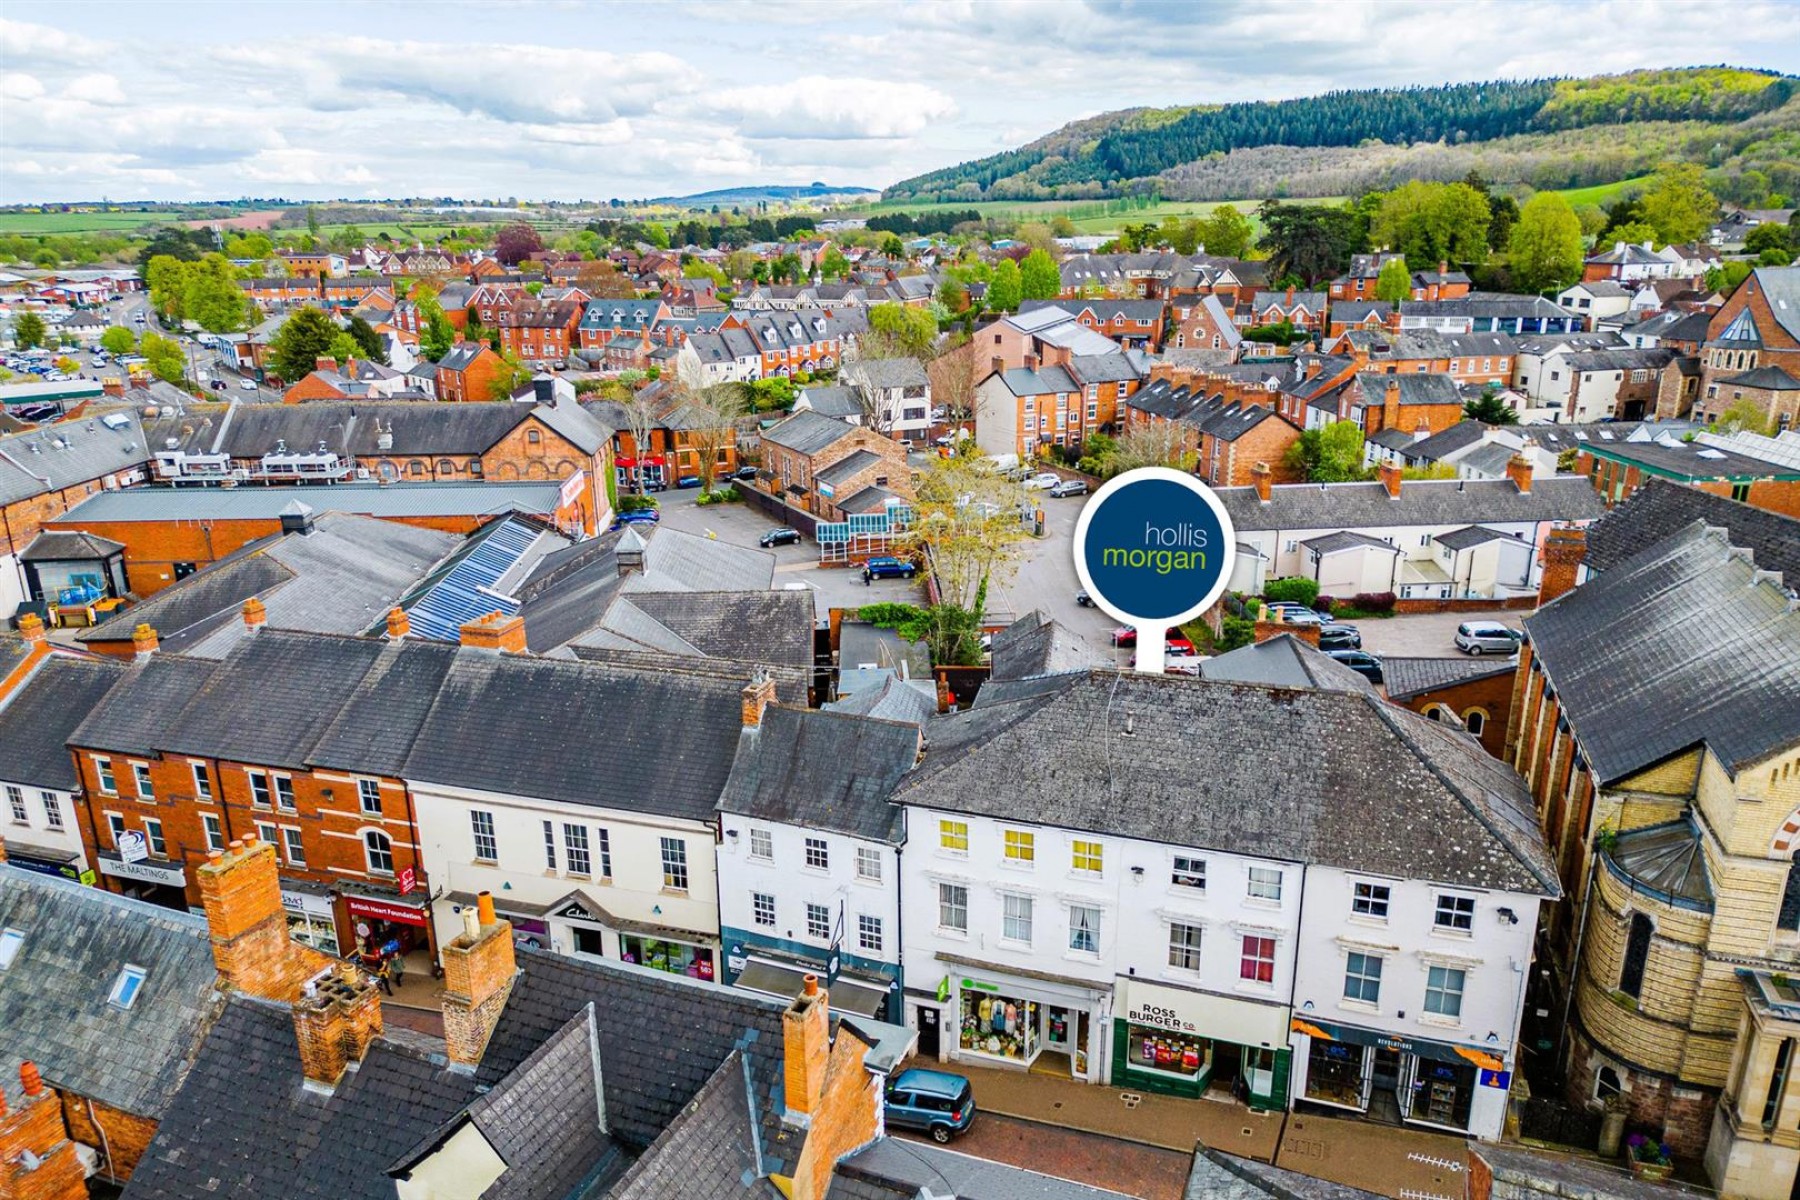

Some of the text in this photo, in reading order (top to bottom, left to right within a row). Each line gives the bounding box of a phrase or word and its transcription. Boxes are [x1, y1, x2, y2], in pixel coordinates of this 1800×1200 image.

[110, 861, 169, 881] THE MALTINGS
[350, 902, 422, 921] British Heart Foundation
[566, 908, 597, 921] Clarks
[1129, 1010, 1181, 1028] BURGER
[1142, 1003, 1176, 1019] ROSS
